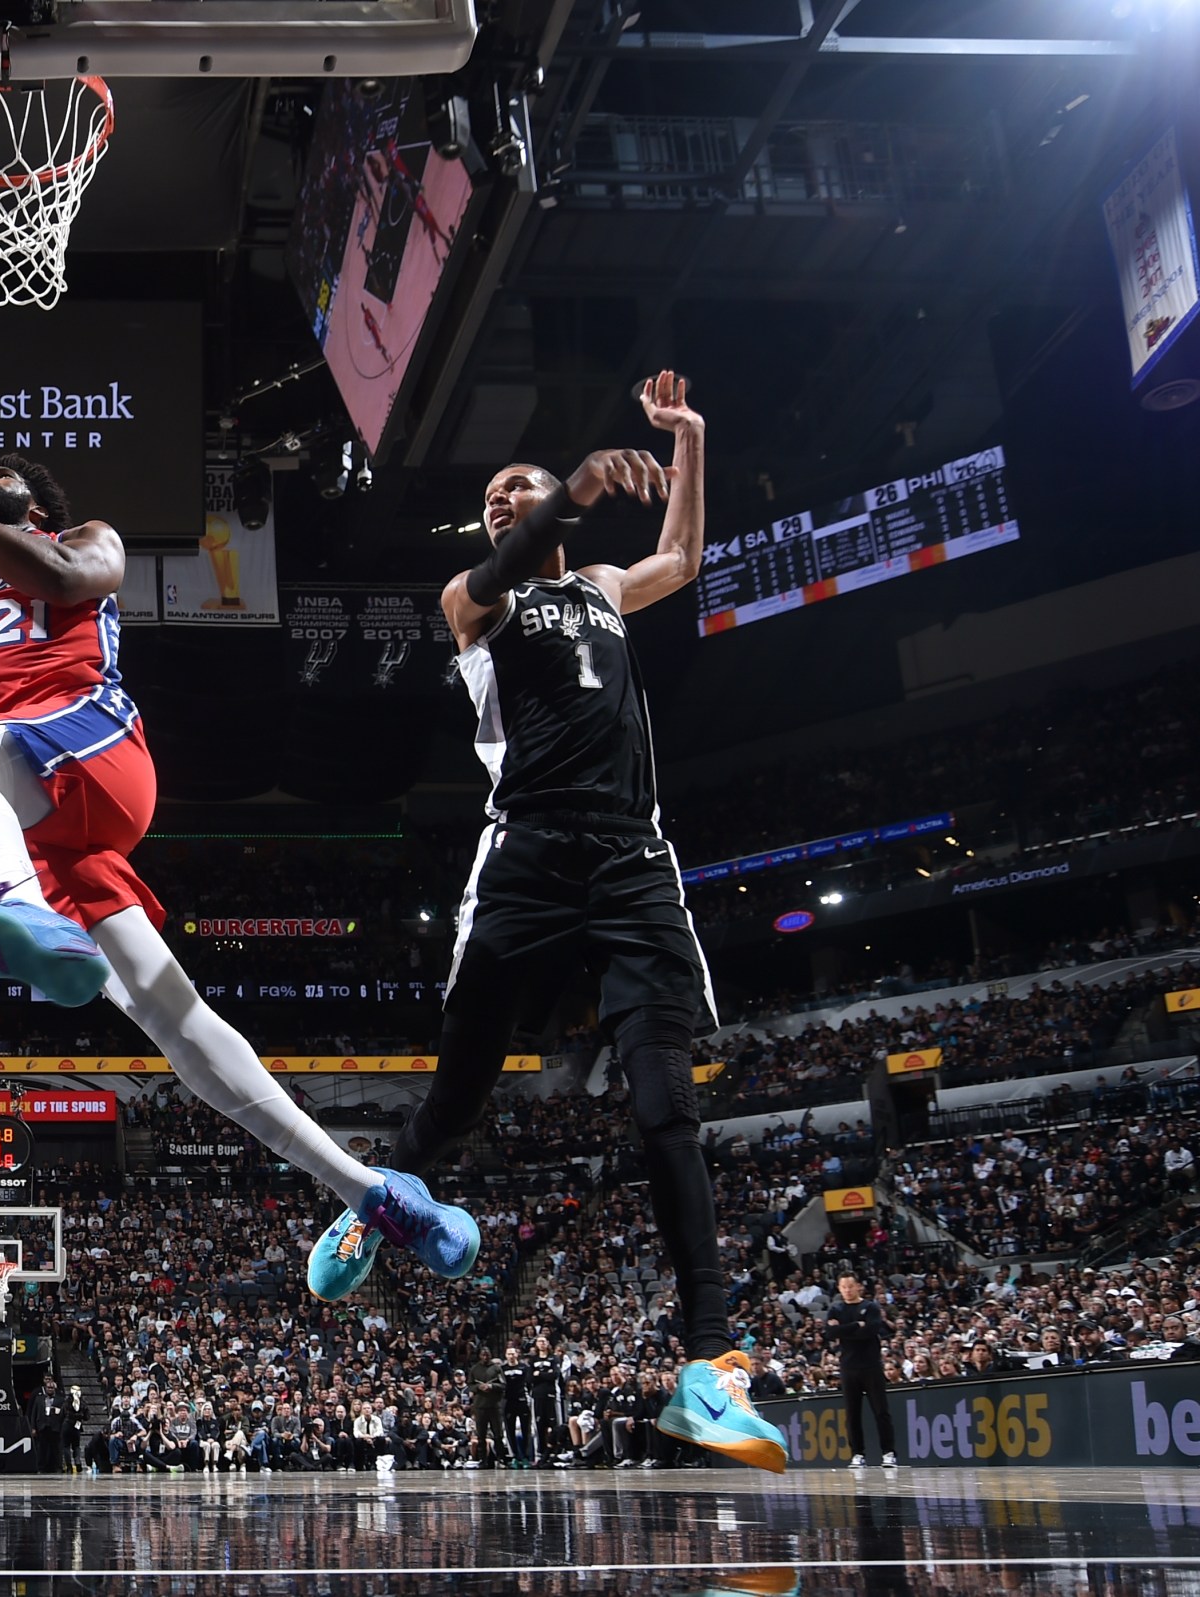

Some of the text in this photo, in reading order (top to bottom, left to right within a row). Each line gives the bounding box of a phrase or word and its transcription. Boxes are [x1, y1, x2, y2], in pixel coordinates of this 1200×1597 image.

[40, 382, 134, 420] Bank
[874, 468, 944, 506] 26 PHI
[744, 516, 802, 548] SA 29
[304, 597, 344, 607] NBA
[374, 597, 414, 607] NBA
[291, 629, 348, 640] 2007
[363, 629, 422, 640] 2013
[575, 641, 603, 688] 1
[915, 818, 944, 832] ULTRA
[704, 866, 729, 880] ULTRA
[952, 862, 1070, 895] Americus Diamond
[200, 918, 343, 937] BURGERTECA
[7, 986, 22, 997] 1ST
[206, 985, 367, 998] PF 4 FG% 37.5 TO 6
[34, 1102, 47, 1112] OF
[50, 1102, 68, 1112] THE
[71, 1102, 106, 1112] SPURS
[169, 1144, 214, 1156] BASELINE
[906, 1393, 1052, 1460] bet365
[778, 1408, 852, 1462] t365
